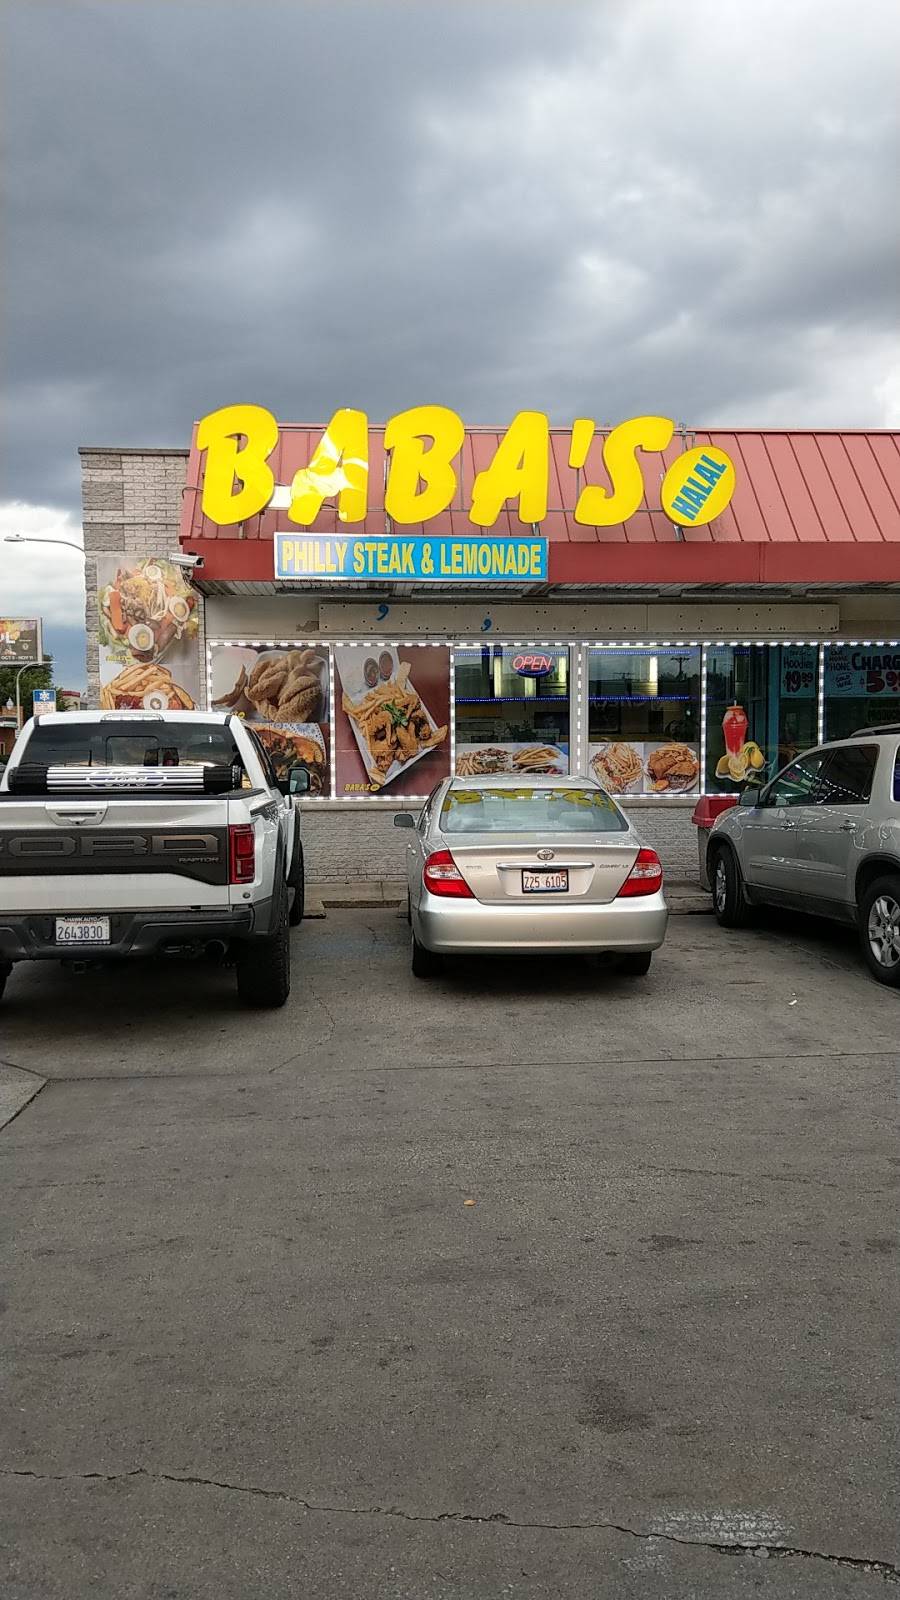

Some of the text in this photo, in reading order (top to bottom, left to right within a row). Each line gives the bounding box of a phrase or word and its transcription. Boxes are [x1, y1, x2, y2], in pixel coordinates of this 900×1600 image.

[197, 404, 674, 526] BABA'S
[671, 454, 728, 521] HALAL
[281, 541, 542, 575] PHILLY STEAK & LEMONADE
[512, 655, 553, 671] OPEN
[178, 856, 219, 864] RAPTOR
[524, 875, 567, 889] Z25 6105
[57, 925, 103, 940] 2643830
